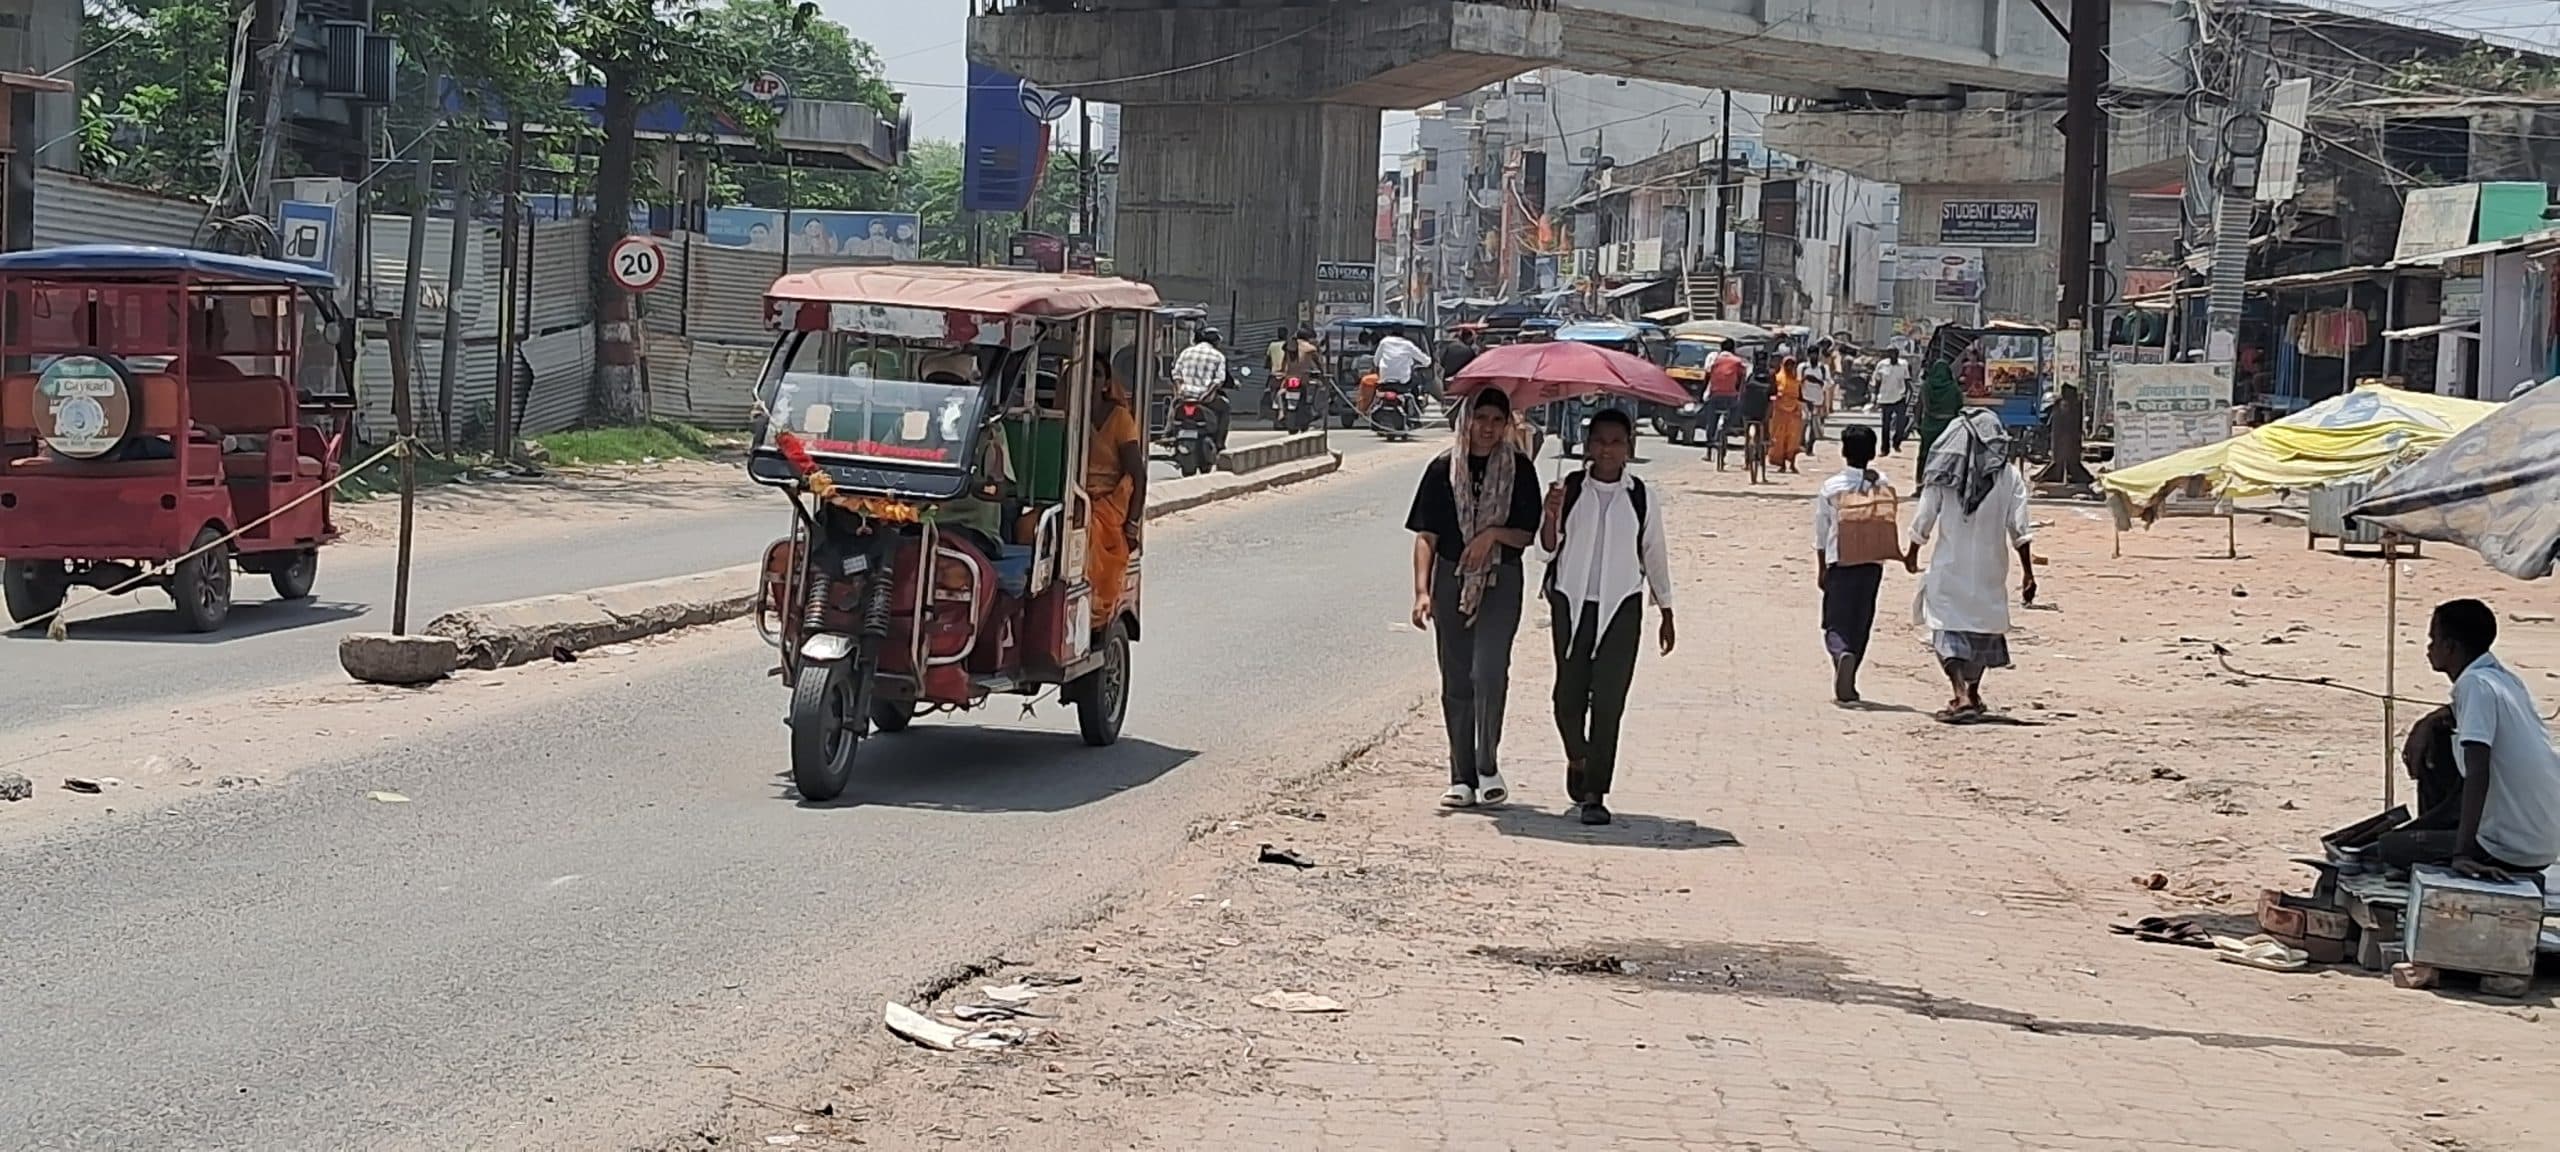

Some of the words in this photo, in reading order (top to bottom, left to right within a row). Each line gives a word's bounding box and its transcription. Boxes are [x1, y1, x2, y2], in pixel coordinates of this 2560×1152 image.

[753, 79, 779, 94] HP
[1943, 203, 1990, 219] STUDENT
[1991, 203, 2036, 219] LIBRARY
[620, 252, 652, 277] 20
